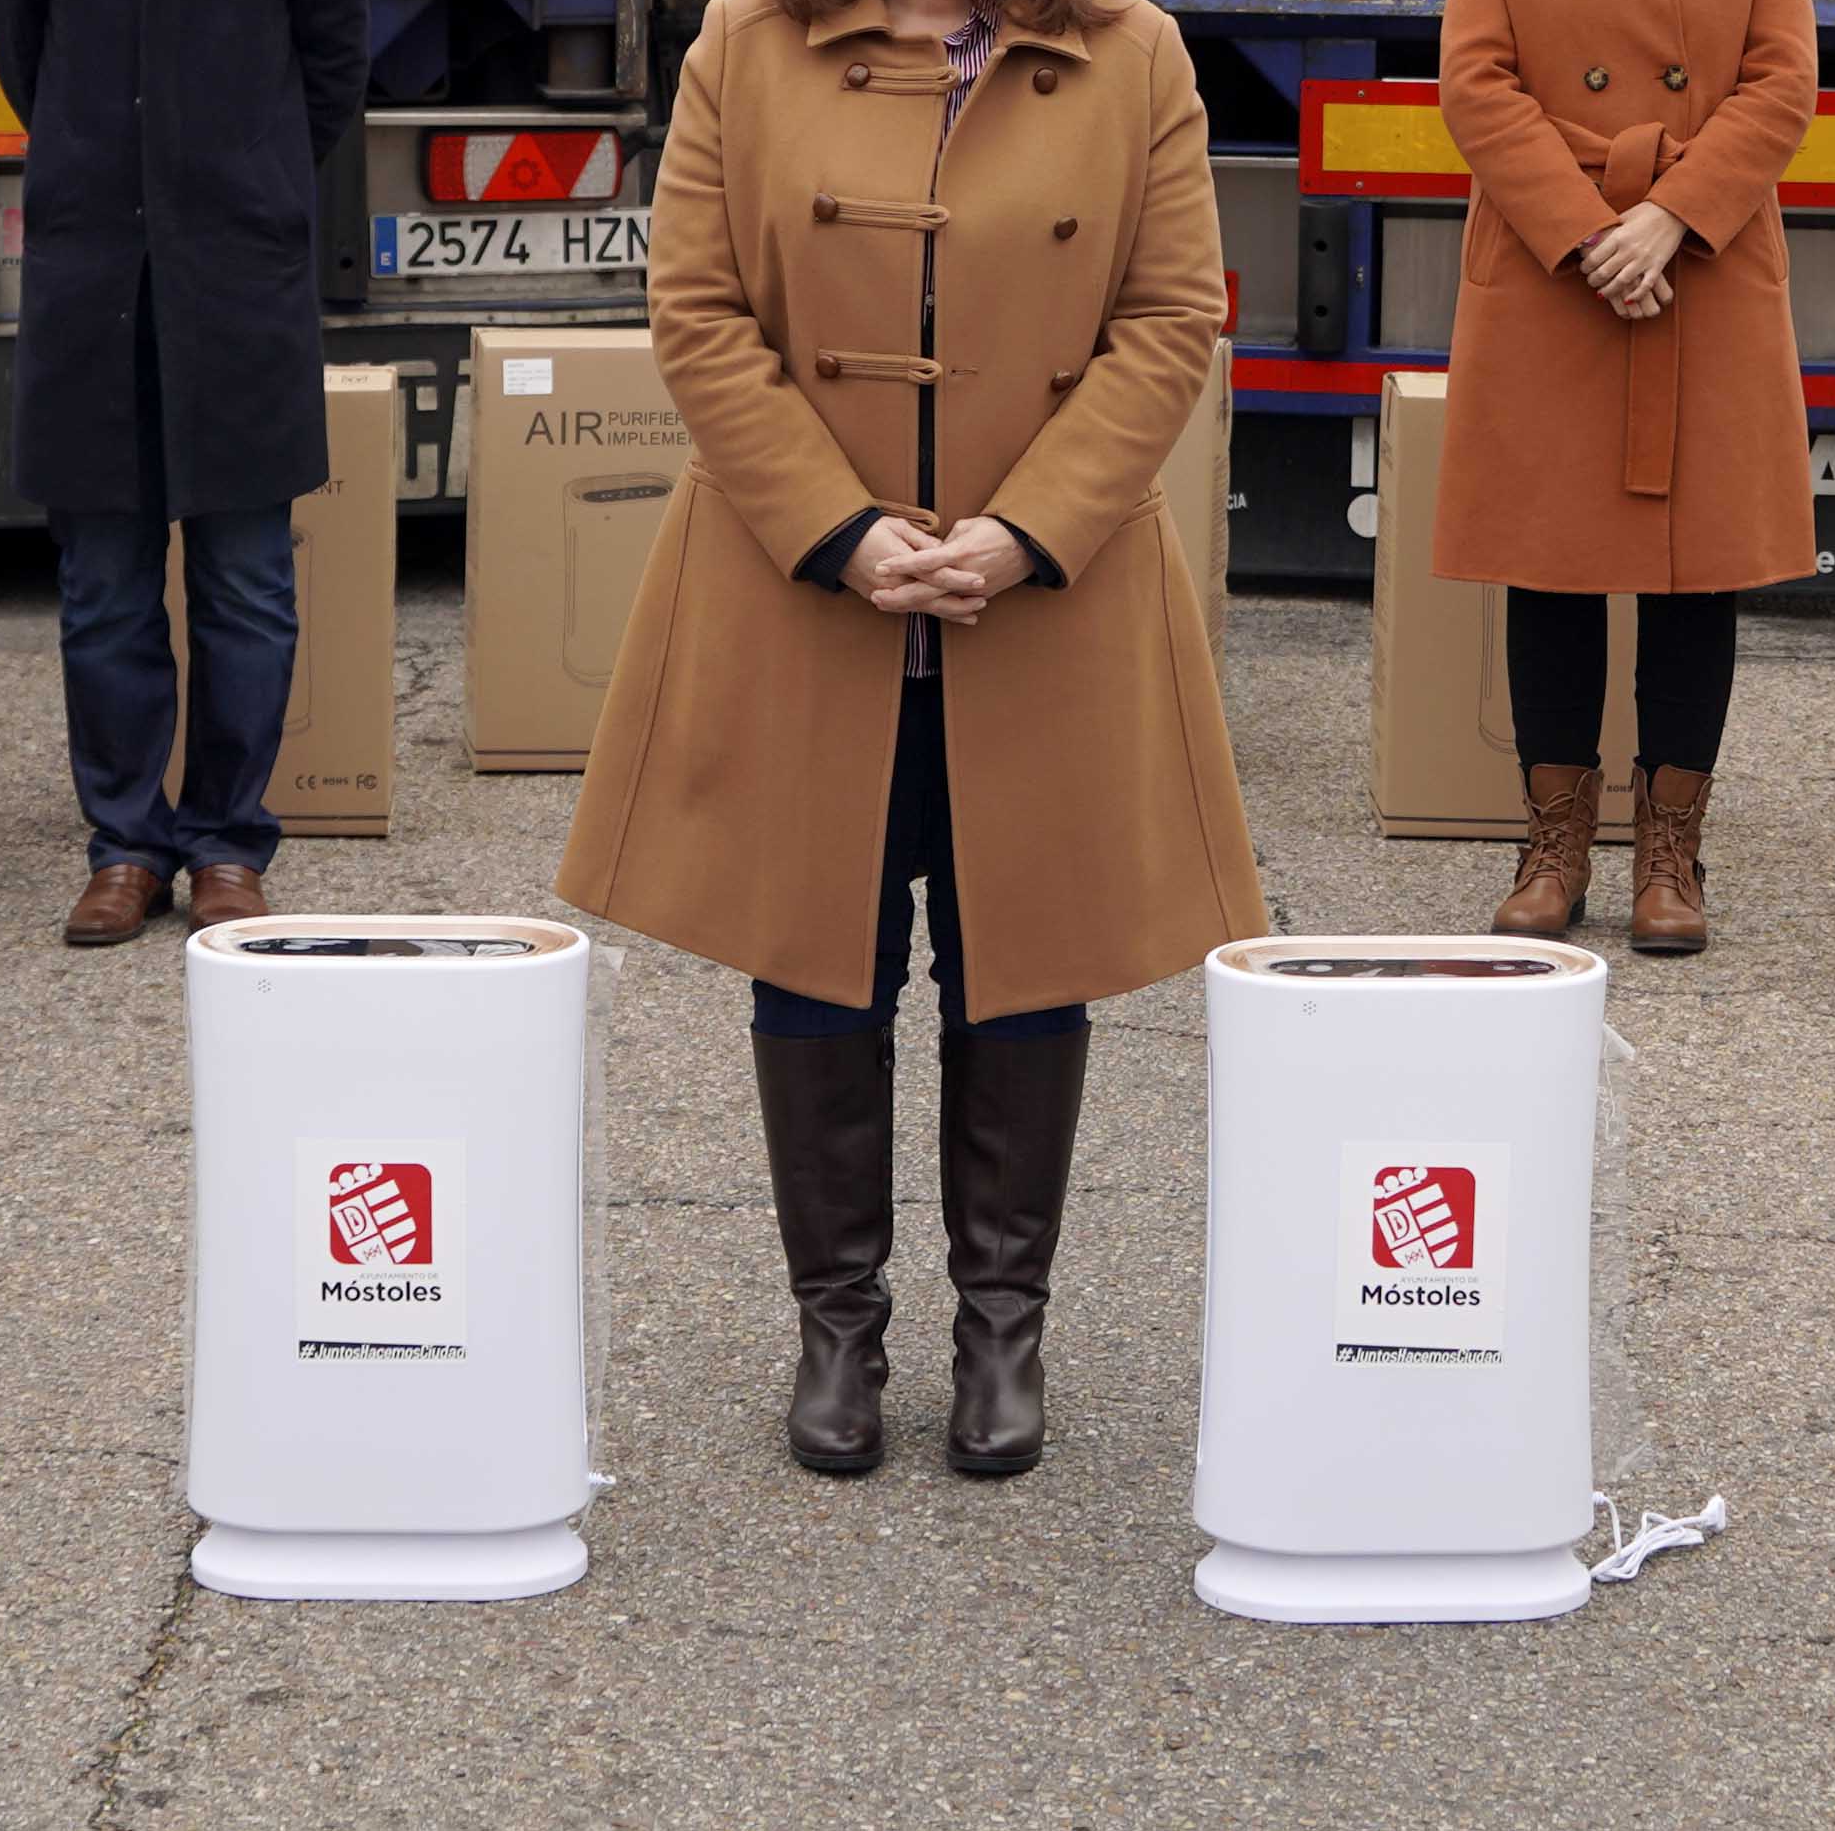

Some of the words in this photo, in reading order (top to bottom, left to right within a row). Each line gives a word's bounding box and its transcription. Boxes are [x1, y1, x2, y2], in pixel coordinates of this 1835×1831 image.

[408, 220, 529, 267] 2574
[563, 217, 651, 263] HZN
[525, 411, 604, 445] AIR
[607, 430, 692, 447] IMPLEME
[1227, 493, 1247, 510] CIA
[322, 1281, 442, 1302] Móstoles
[1362, 1284, 1480, 1306] Móstoles
[300, 1343, 467, 1359] #JuntosHacemosCiudad
[1337, 1347, 1502, 1364] #JuntosHacemosCiudad
